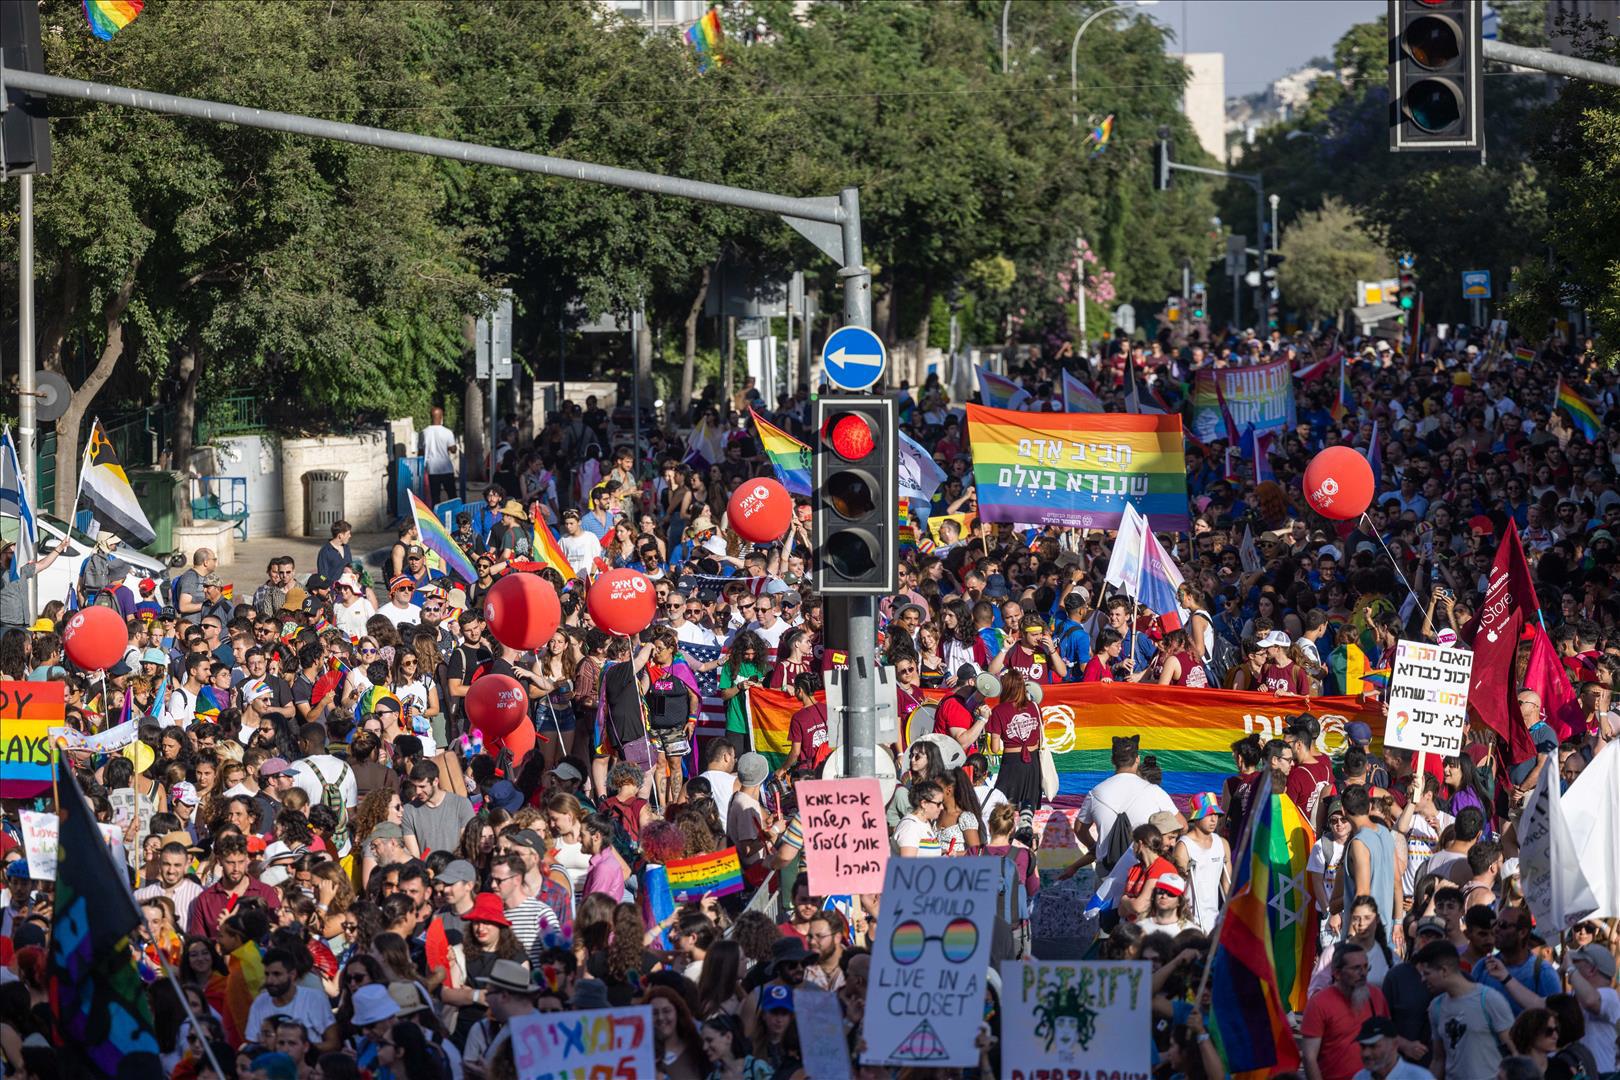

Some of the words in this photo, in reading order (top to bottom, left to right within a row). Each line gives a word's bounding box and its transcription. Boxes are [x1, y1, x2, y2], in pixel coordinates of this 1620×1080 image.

[611, 579, 632, 589] איגי
[1440, 651, 1472, 667] האם
[1397, 662, 1441, 680] לברוא
[1444, 668, 1470, 684] יכול
[1391, 684, 1425, 701] שהוא
[1412, 708, 1439, 725] יכול
[1443, 714, 1463, 728] לא
[1420, 732, 1459, 750] להכיל
[0, 735, 51, 766] AYS
[808, 809, 850, 830] תשלחו
[861, 811, 877, 829] אל
[809, 832, 847, 850] לטיפולי
[853, 838, 880, 853] אותי
[892, 865, 936, 895] NO
[944, 865, 991, 893] ONE
[912, 895, 975, 917] SHOULD
[878, 967, 925, 988] LIVE
[938, 969, 959, 991] IN
[966, 973, 978, 992] A
[1022, 964, 1143, 1011] PETRIFY
[887, 991, 971, 1017] CLOSET
